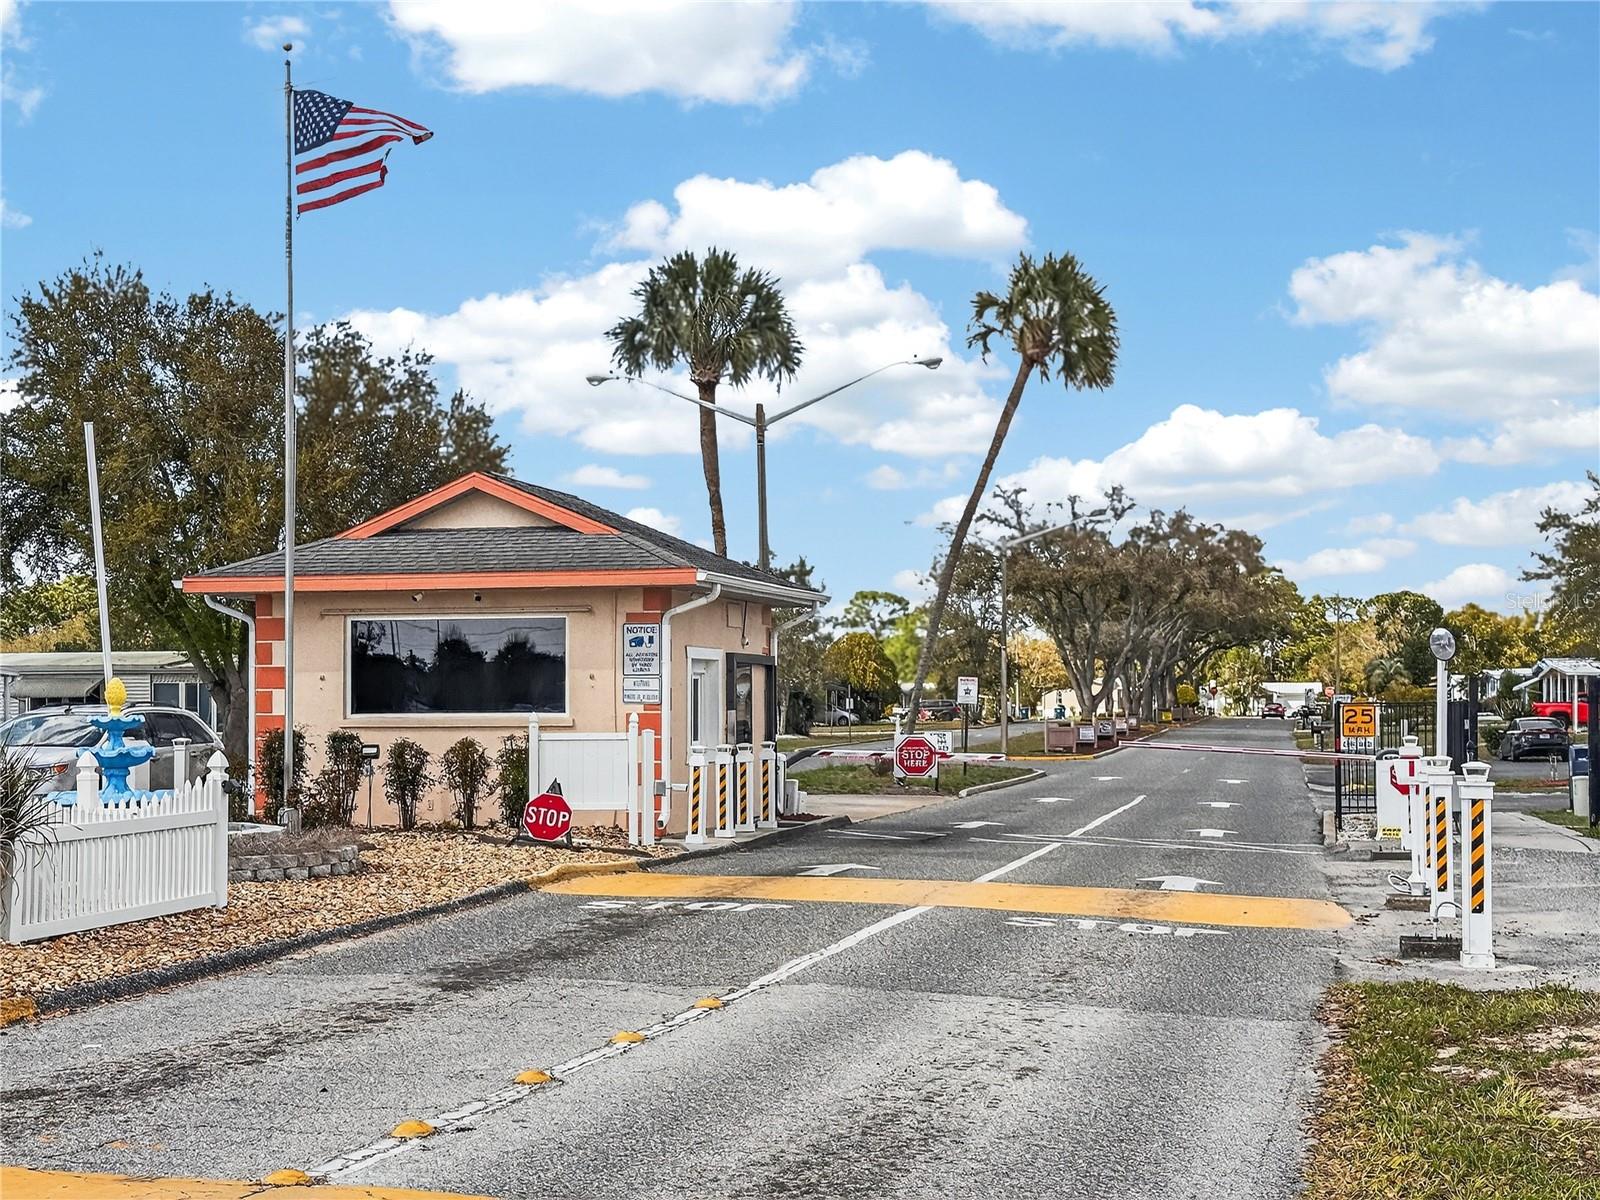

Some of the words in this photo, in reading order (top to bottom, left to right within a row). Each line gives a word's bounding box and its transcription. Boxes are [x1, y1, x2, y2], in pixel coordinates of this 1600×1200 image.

[626, 626, 657, 634] NOTICE
[1344, 708, 1374, 724] 25
[901, 749, 931, 760] STOP
[903, 760, 929, 768] HERE
[526, 806, 569, 828] STOP
